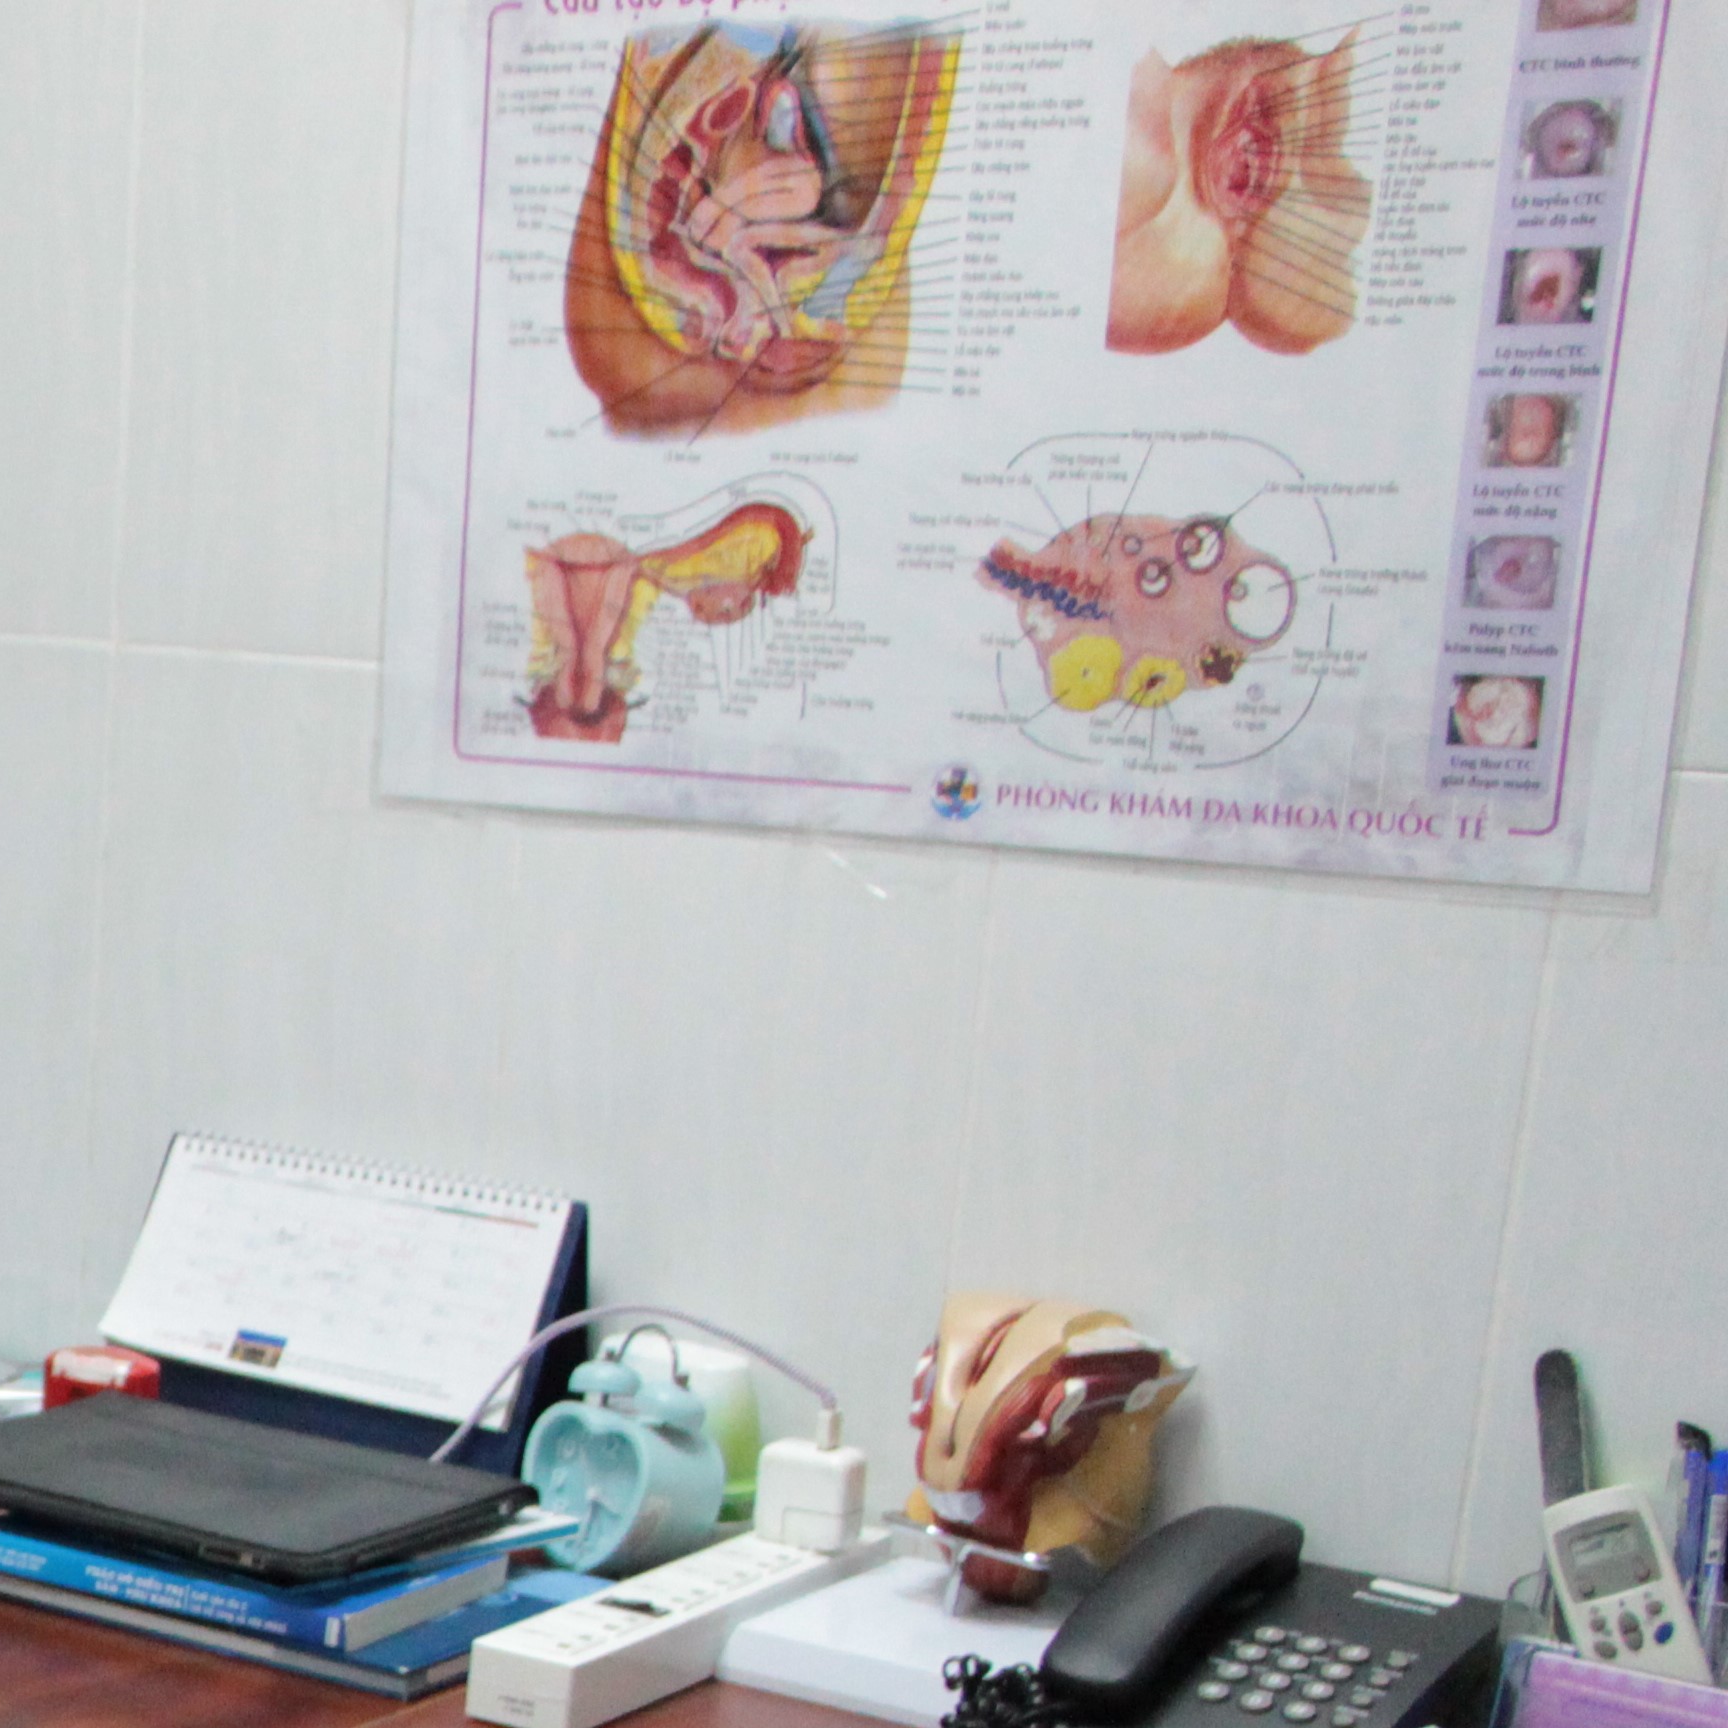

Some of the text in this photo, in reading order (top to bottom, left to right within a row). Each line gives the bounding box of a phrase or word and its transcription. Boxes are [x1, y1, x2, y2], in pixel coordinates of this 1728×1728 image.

[1573, 191, 1606, 205] CTC
[1557, 344, 1586, 358] CTC
[1533, 484, 1565, 497] CTC
[1508, 624, 1540, 636] CTC
[1109, 788, 1193, 819] KHÁM
[1252, 802, 1338, 830] KHOA
[1348, 799, 1442, 839] QUỐC
[1458, 803, 1488, 841] TẾ
